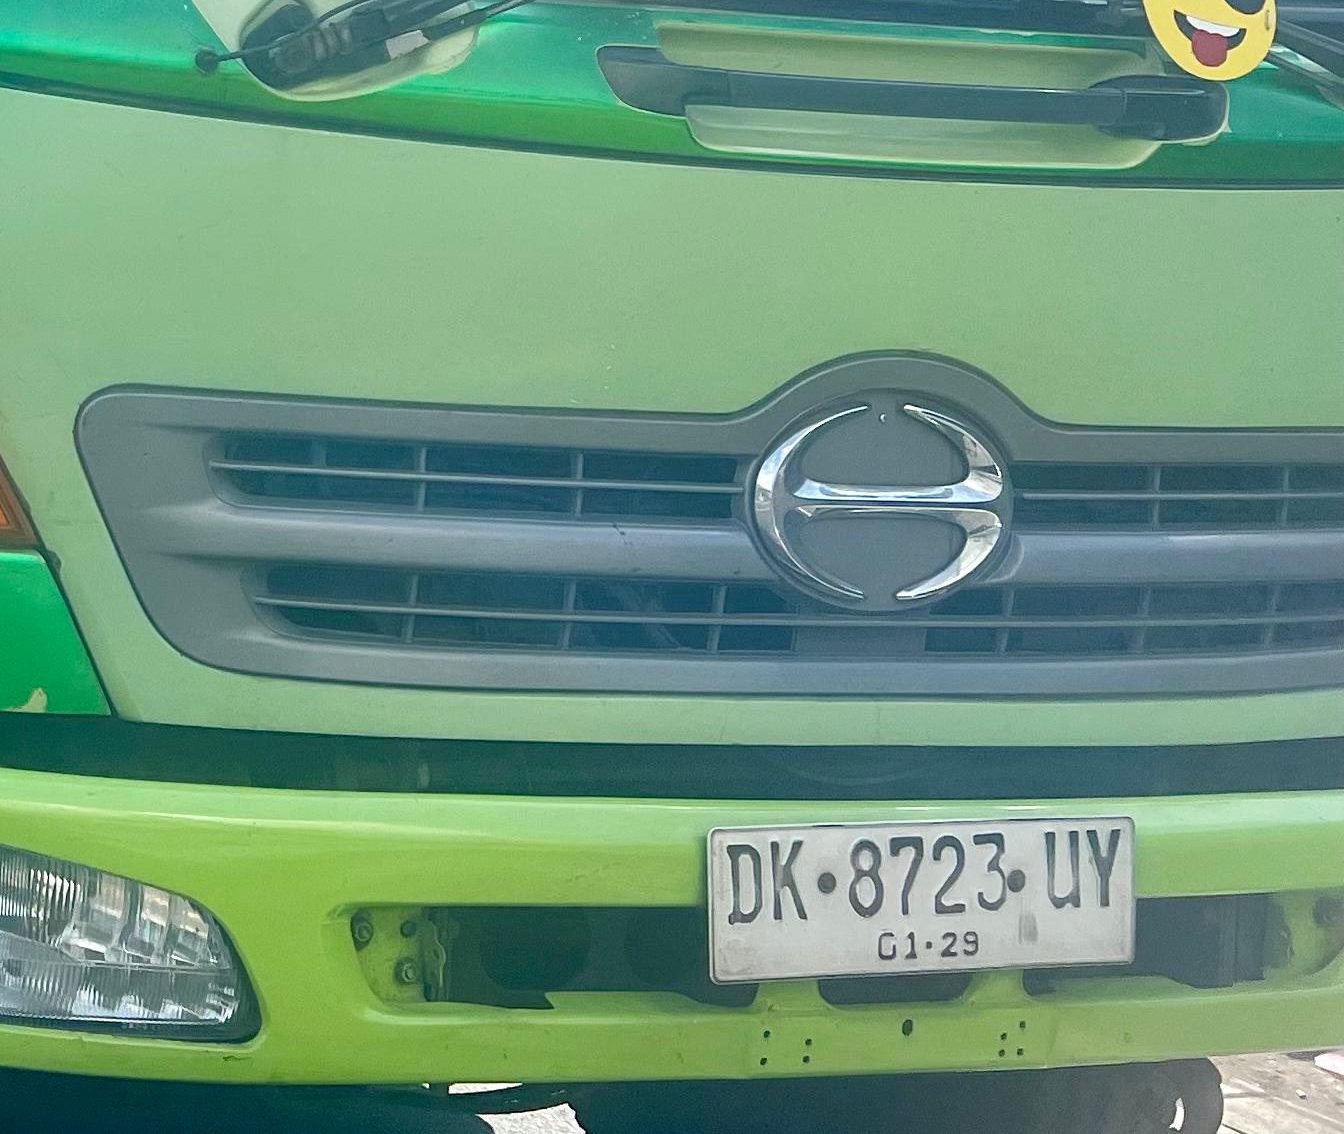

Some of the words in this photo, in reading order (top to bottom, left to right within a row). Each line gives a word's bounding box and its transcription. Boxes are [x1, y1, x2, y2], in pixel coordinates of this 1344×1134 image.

[726, 839, 808, 926] DK
[848, 832, 1009, 919] 8723
[1043, 828, 1121, 909] UY
